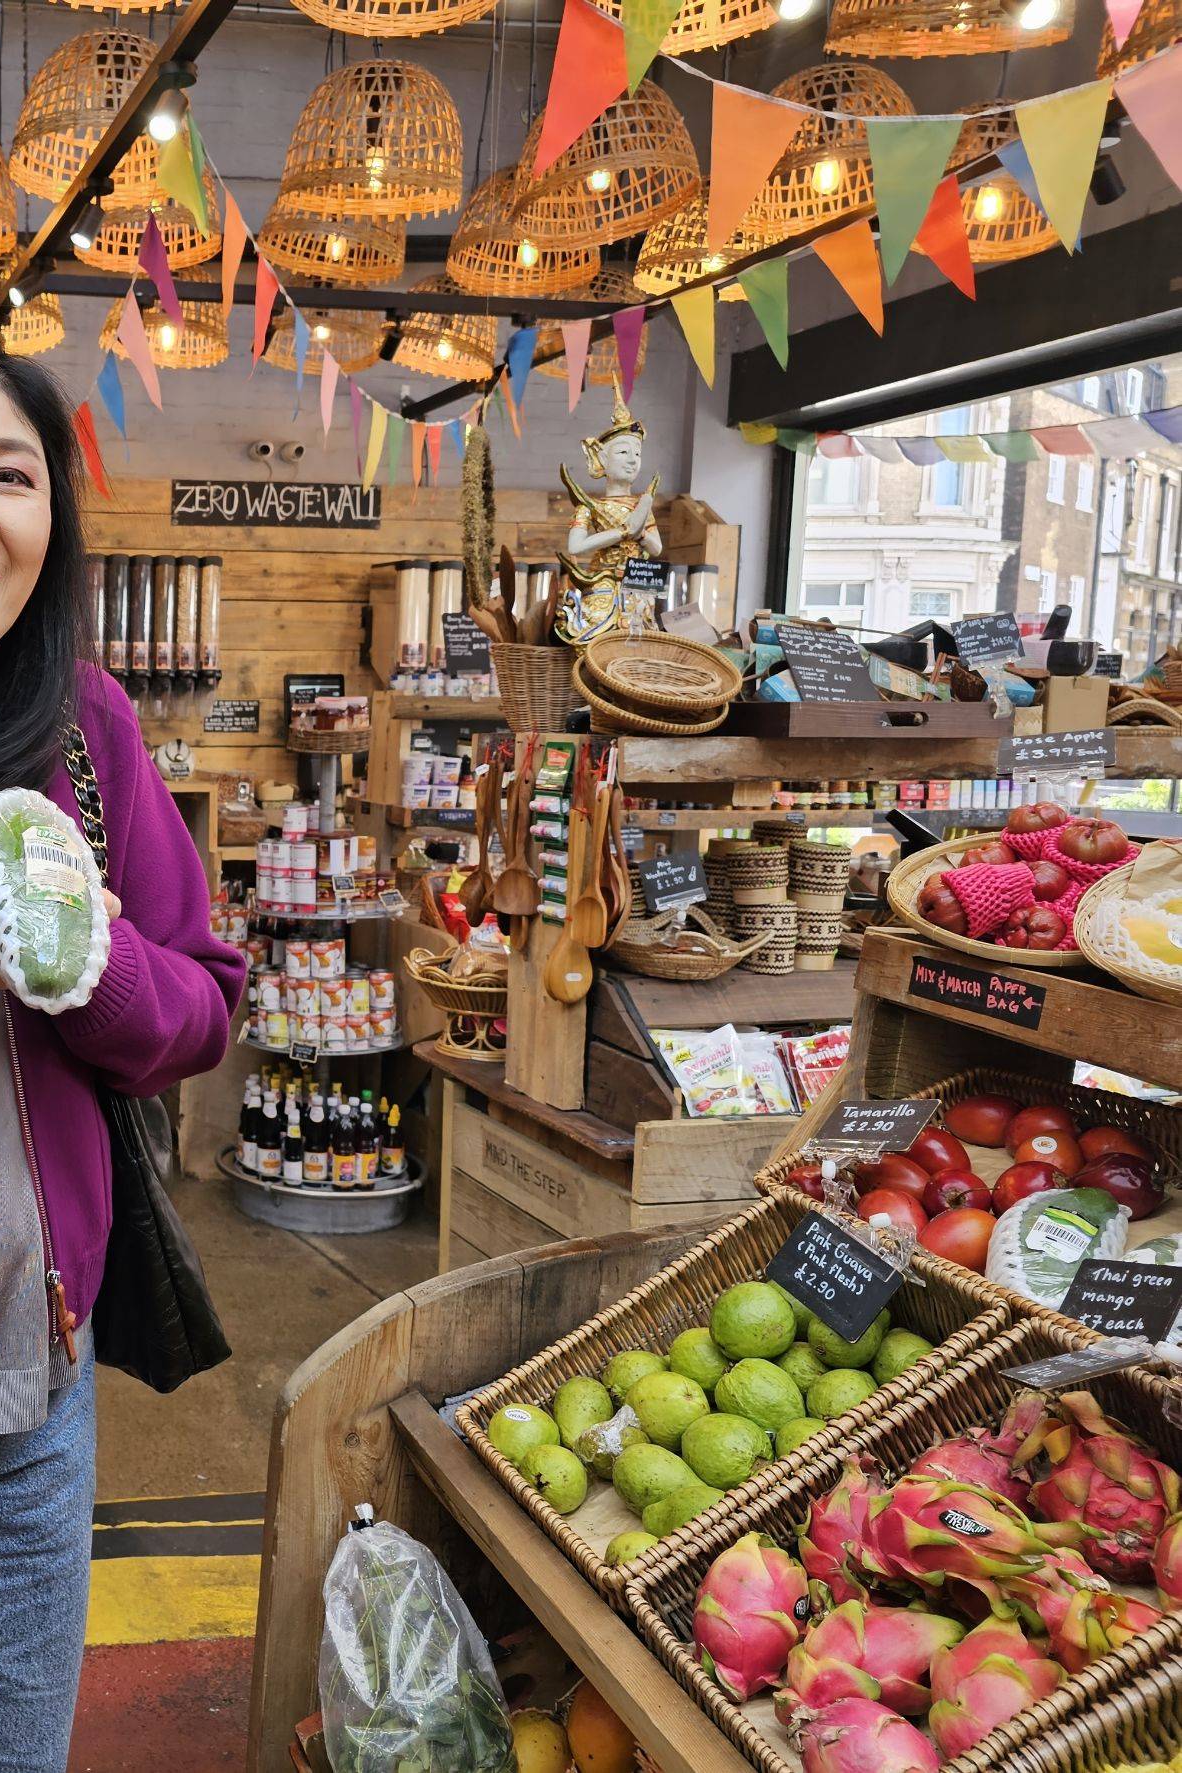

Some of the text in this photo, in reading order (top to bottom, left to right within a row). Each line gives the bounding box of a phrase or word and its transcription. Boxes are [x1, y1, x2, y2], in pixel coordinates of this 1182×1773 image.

[174, 482, 381, 521] ZERO WASTE WALL
[1011, 731, 1104, 746] Rose Apple
[1015, 747, 1073, 760] £3.99
[915, 965, 1027, 997] MIX & MATCH PAPER
[986, 994, 1019, 1014] BAG
[842, 1104, 916, 1118] Tamarillo
[841, 1120, 895, 1133] £2.90
[510, 1154, 531, 1182] THE
[533, 1170, 567, 1198] STEP
[805, 1221, 873, 1282] Pink Guava
[798, 1241, 864, 1296] (Pink flesh)
[1092, 1267, 1173, 1288] Thai green
[793, 1262, 836, 1300] £2.90
[1081, 1291, 1135, 1311] mango
[1105, 1317, 1145, 1330] each
